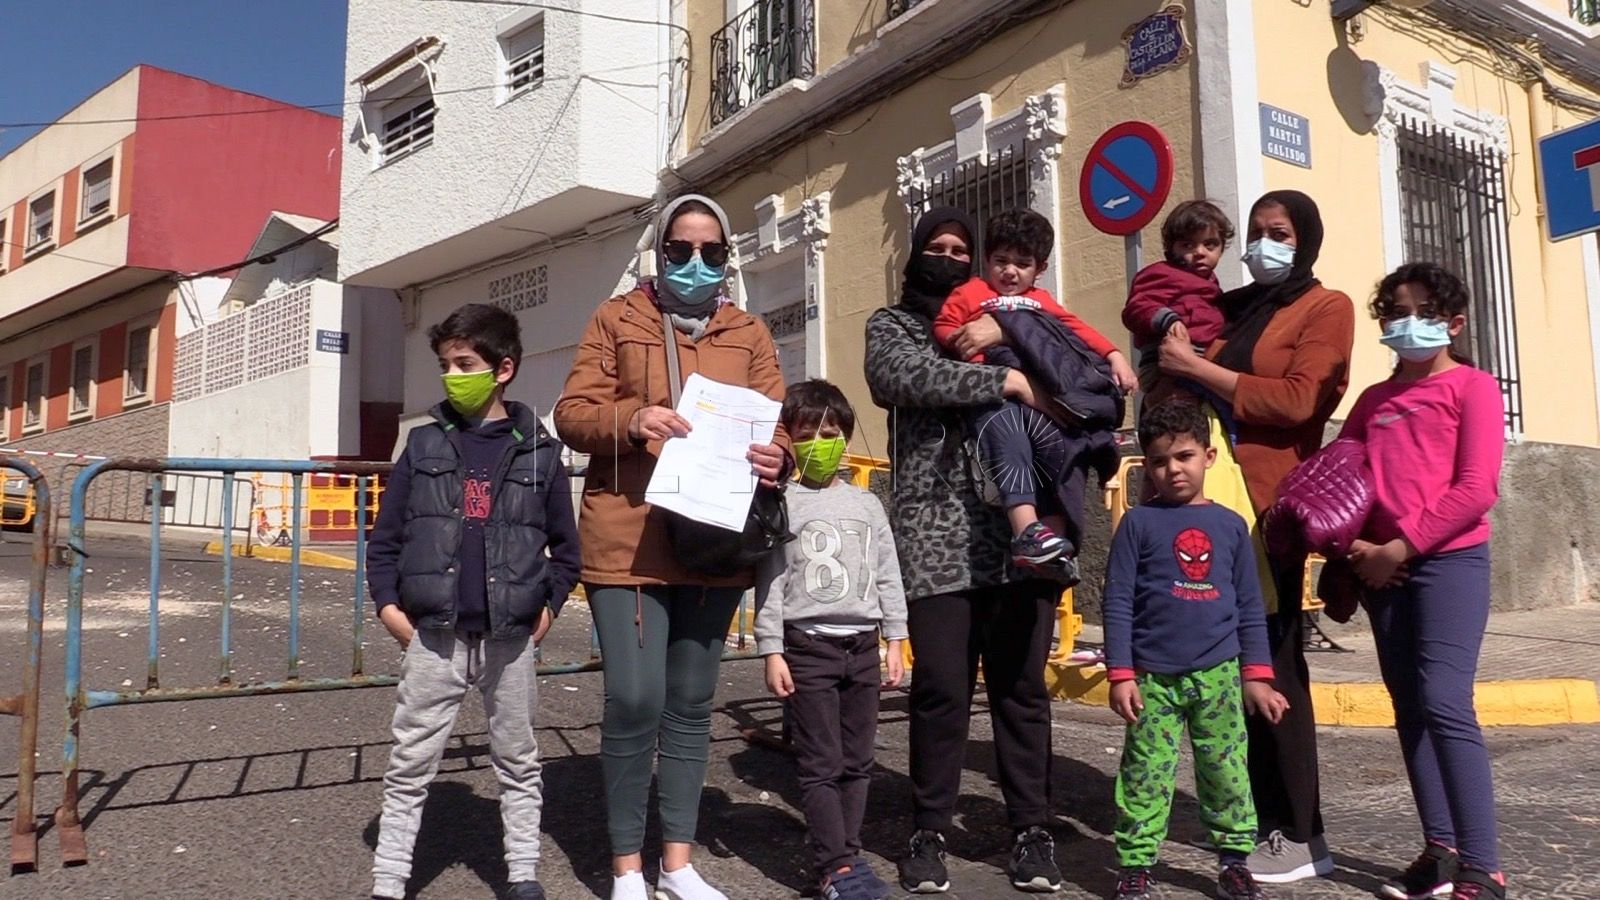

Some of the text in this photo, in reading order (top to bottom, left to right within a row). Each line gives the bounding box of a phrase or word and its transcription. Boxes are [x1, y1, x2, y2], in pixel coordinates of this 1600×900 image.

[1140, 20, 1168, 40] CALLE
[1271, 110, 1299, 129] CALLE
[1269, 125, 1302, 146] MARTIN
[1267, 142, 1306, 163] GALINDO
[801, 518, 872, 604] 87
